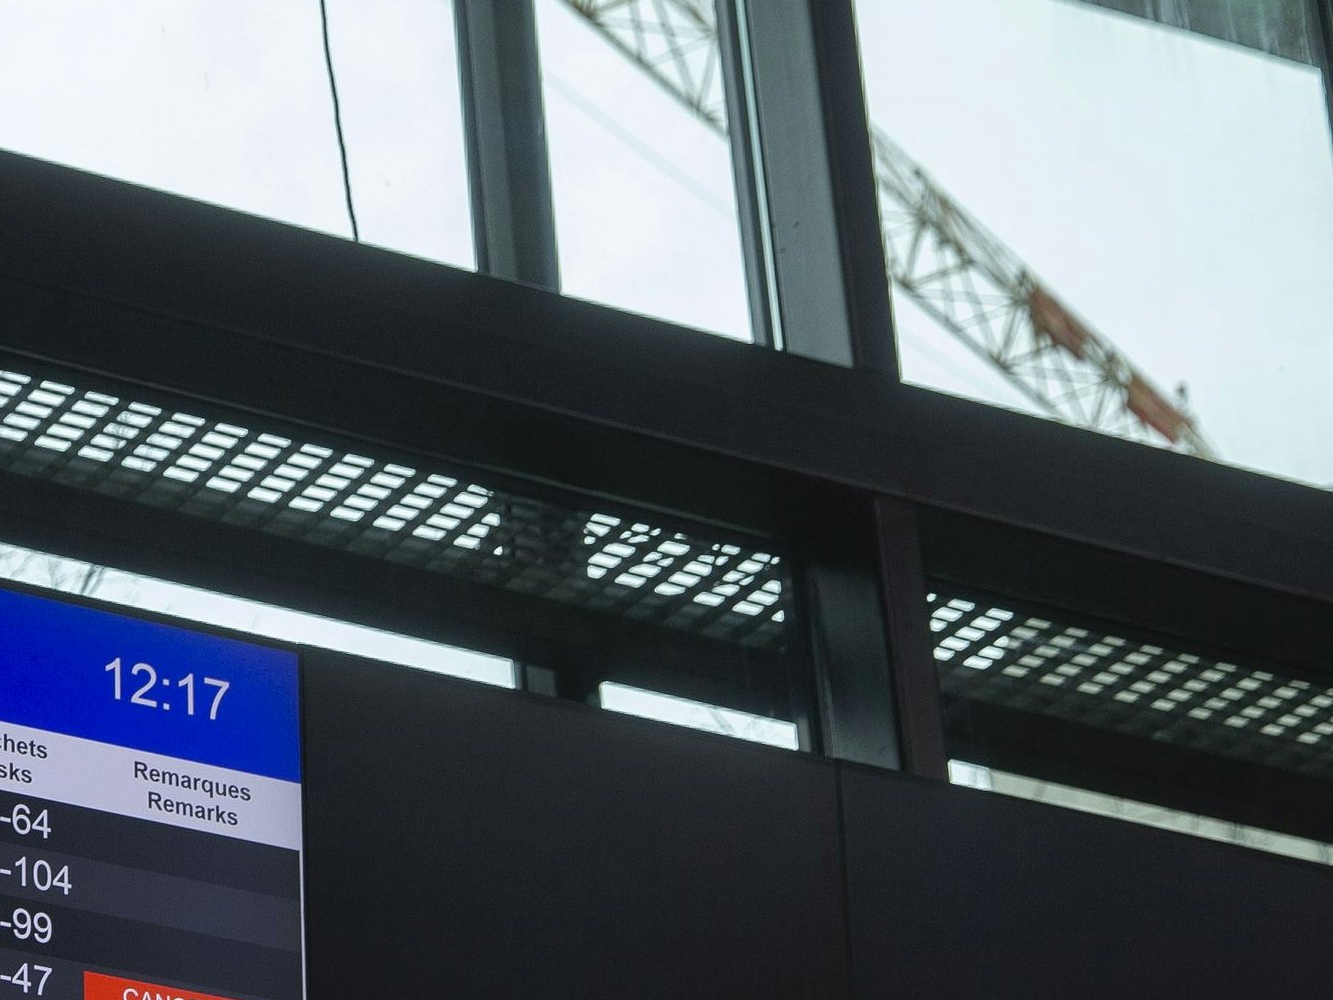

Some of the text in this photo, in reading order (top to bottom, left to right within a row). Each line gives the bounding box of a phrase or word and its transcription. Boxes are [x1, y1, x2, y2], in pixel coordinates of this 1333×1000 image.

[106, 658, 229, 720] 12:17
[135, 761, 250, 801] Remarques
[149, 791, 237, 825] Remarks
